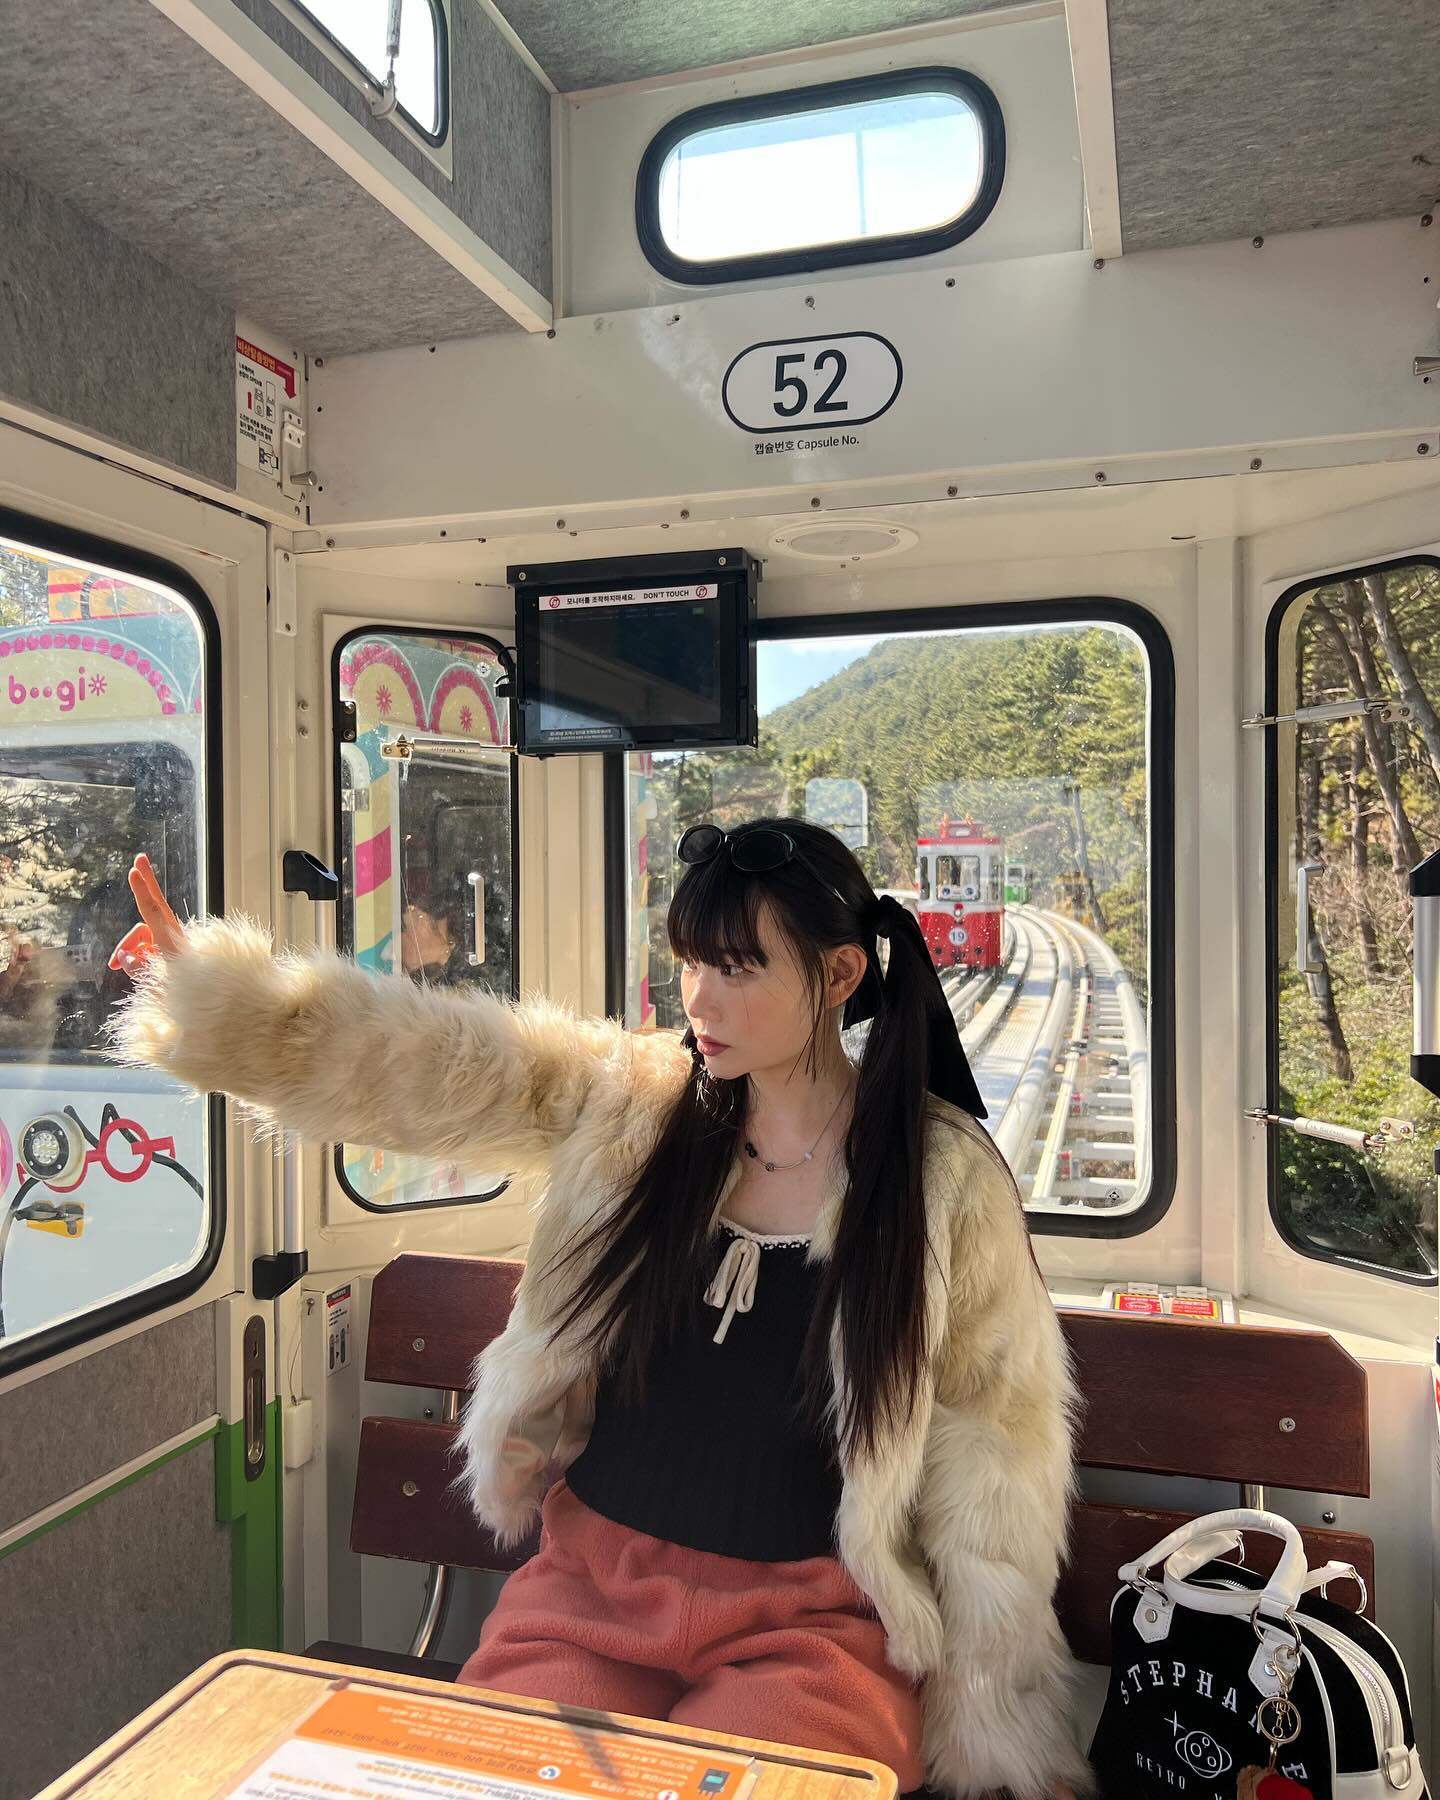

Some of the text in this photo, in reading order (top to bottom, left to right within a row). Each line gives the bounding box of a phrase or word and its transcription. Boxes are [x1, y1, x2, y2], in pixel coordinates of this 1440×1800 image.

[773, 349, 848, 417] 52
[754, 435, 860, 455] 캡슐번호 Capsule No.
[566, 595, 591, 605] 모니터를
[643, 590, 665, 600] DON'T
[665, 589, 690, 599] TOUCH
[951, 931, 965, 942] 19
[1136, 1752, 1186, 1790] RETRO
